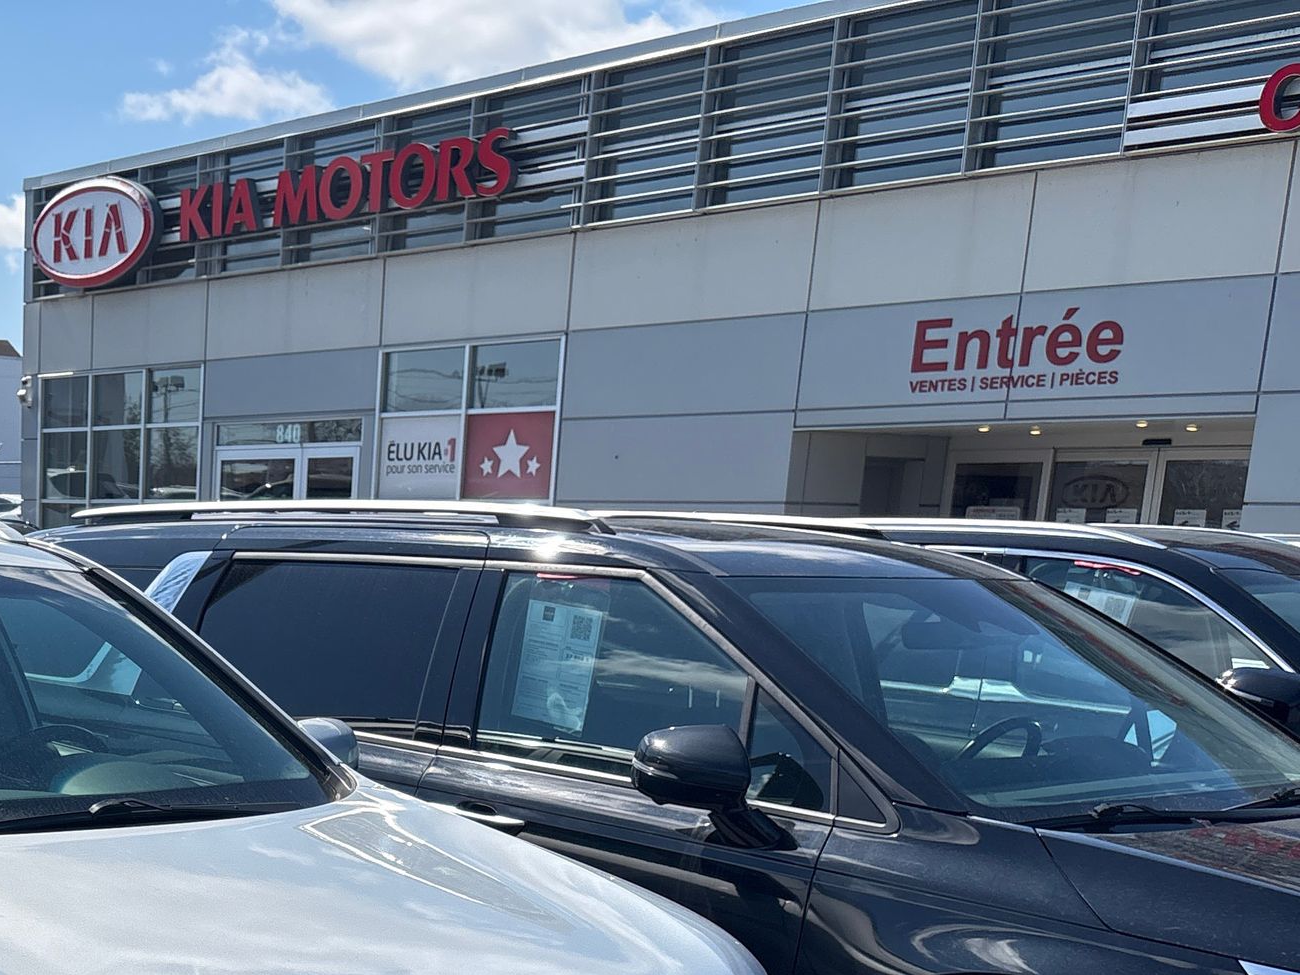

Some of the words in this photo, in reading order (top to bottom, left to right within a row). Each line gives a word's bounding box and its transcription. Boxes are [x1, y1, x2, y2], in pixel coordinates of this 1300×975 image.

[180, 177, 257, 242] KIA
[273, 127, 512, 227] MOTORS
[52, 201, 129, 264] KIA
[910, 307, 1124, 373] Entrée
[909, 378, 967, 393] VENTES
[979, 374, 1046, 390] SERVICE
[1059, 369, 1119, 386] PIÈCES
[276, 424, 300, 443] 840
[387, 440, 414, 461] ÉLU
[417, 441, 442, 461] KIA
[386, 464, 405, 476] pour
[407, 464, 423, 474] son
[425, 462, 456, 474] service
